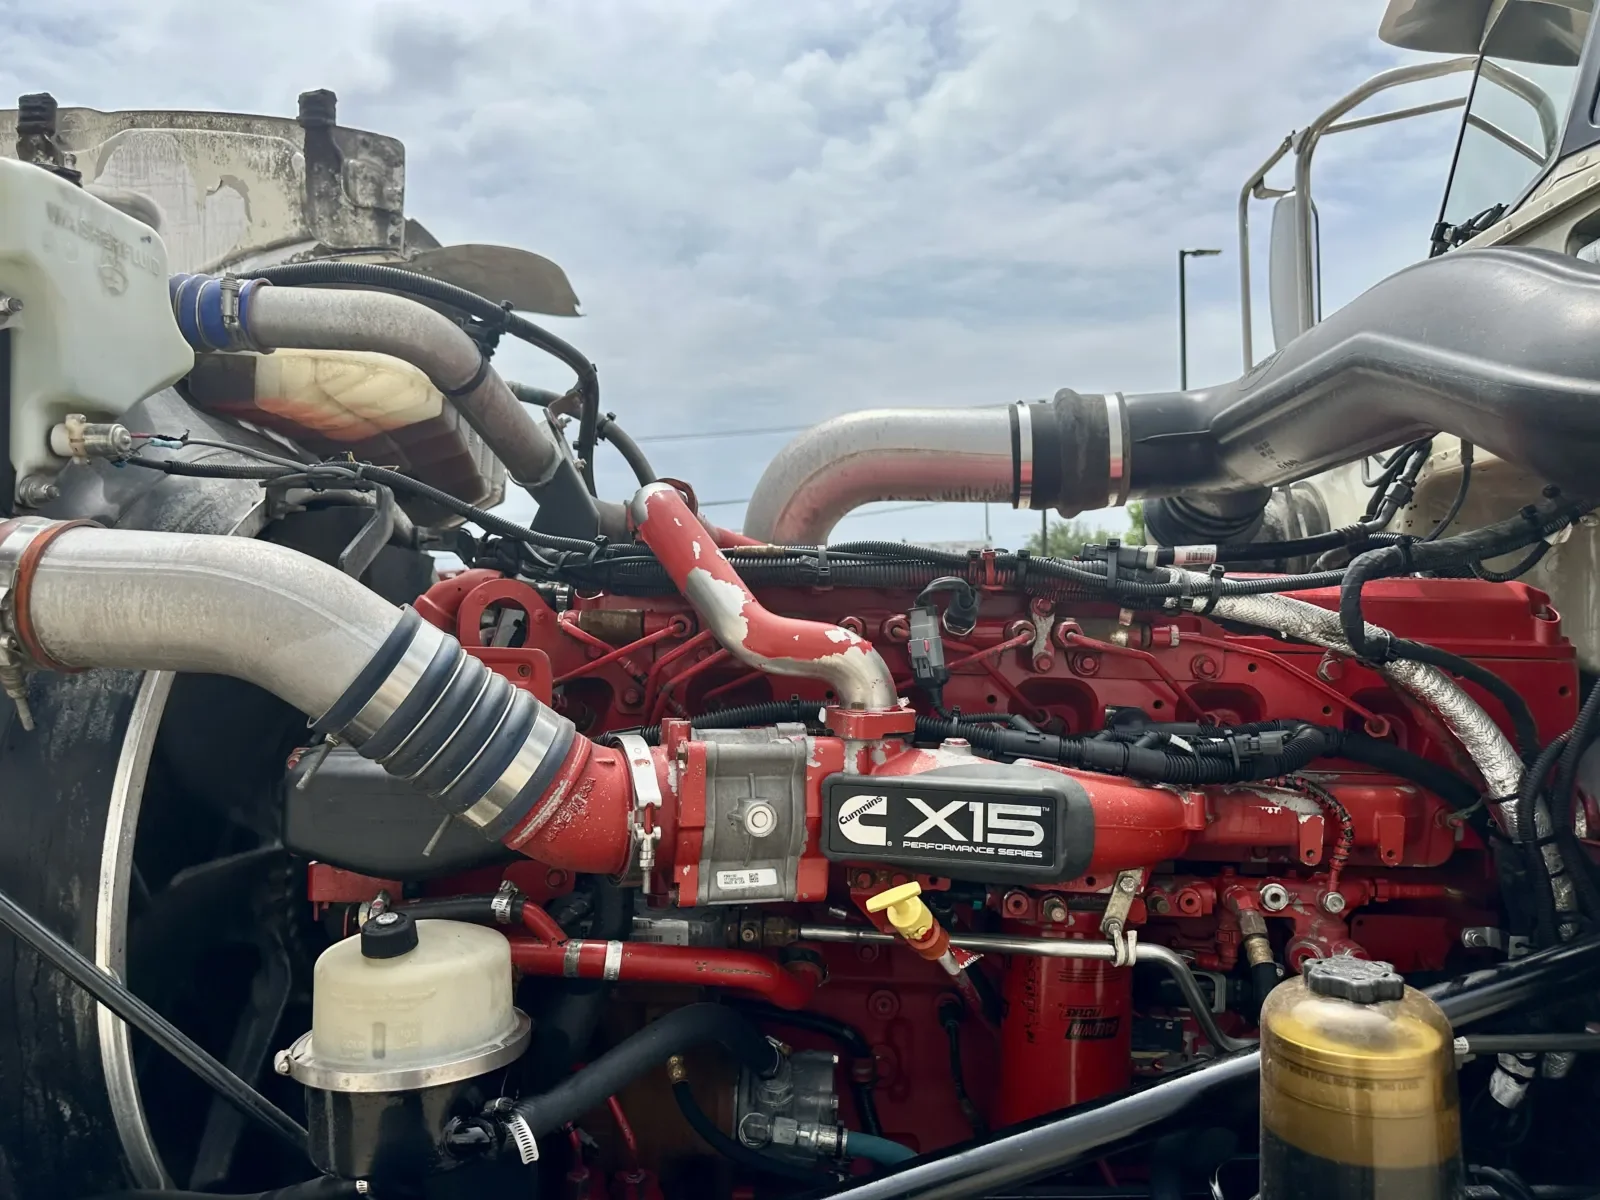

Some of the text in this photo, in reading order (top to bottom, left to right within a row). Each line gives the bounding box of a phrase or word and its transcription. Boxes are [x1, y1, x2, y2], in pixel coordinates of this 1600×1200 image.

[839, 795, 883, 825] Cummins
[903, 840, 1043, 858] PERFORMANCE SERIES
